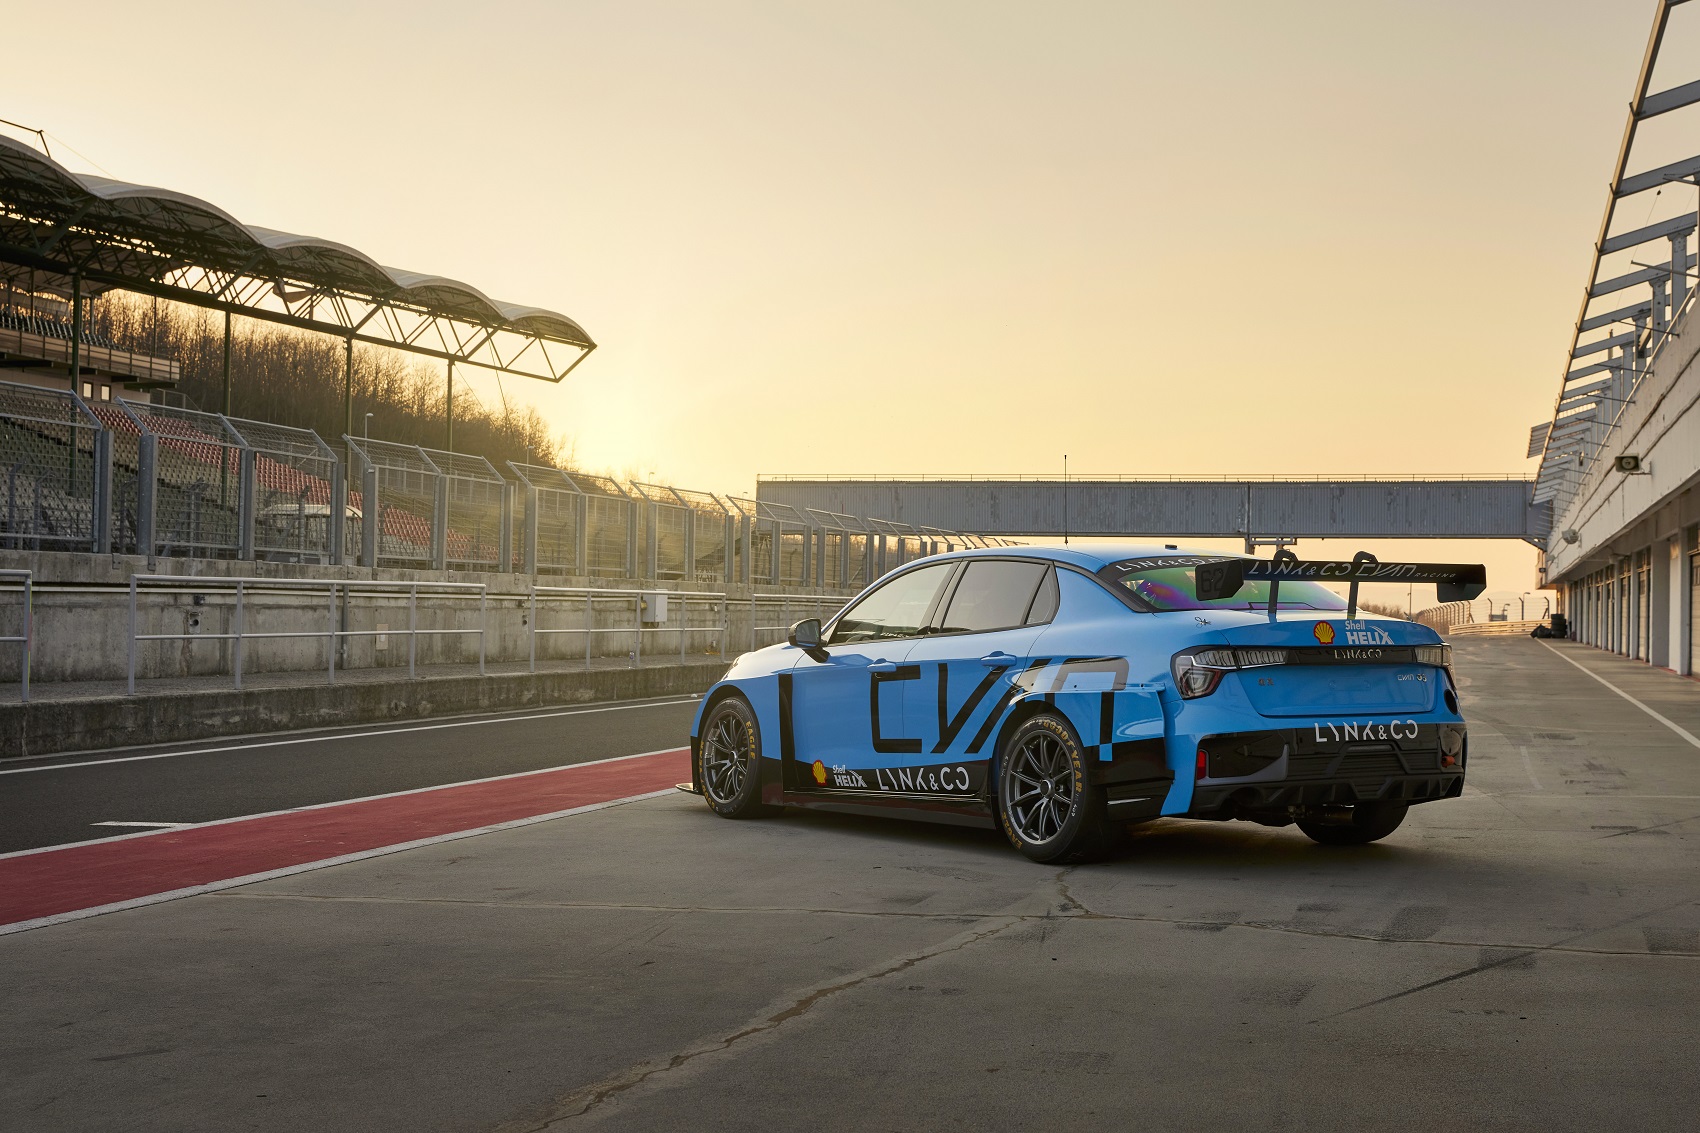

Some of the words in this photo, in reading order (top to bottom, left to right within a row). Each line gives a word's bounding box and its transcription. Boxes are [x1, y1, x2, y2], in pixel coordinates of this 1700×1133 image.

[1345, 620, 1366, 631] Shell
[1346, 631, 1394, 645] HELIX
[1334, 649, 1382, 659] LYNK&CO
[1314, 719, 1418, 743] LYNK&CO
[745, 720, 755, 760] EAGLE
[1043, 718, 1083, 793] GOODYEAR
[832, 765, 846, 774] Shell
[834, 774, 867, 788] HELIX
[876, 766, 970, 791] LYNK&CO
